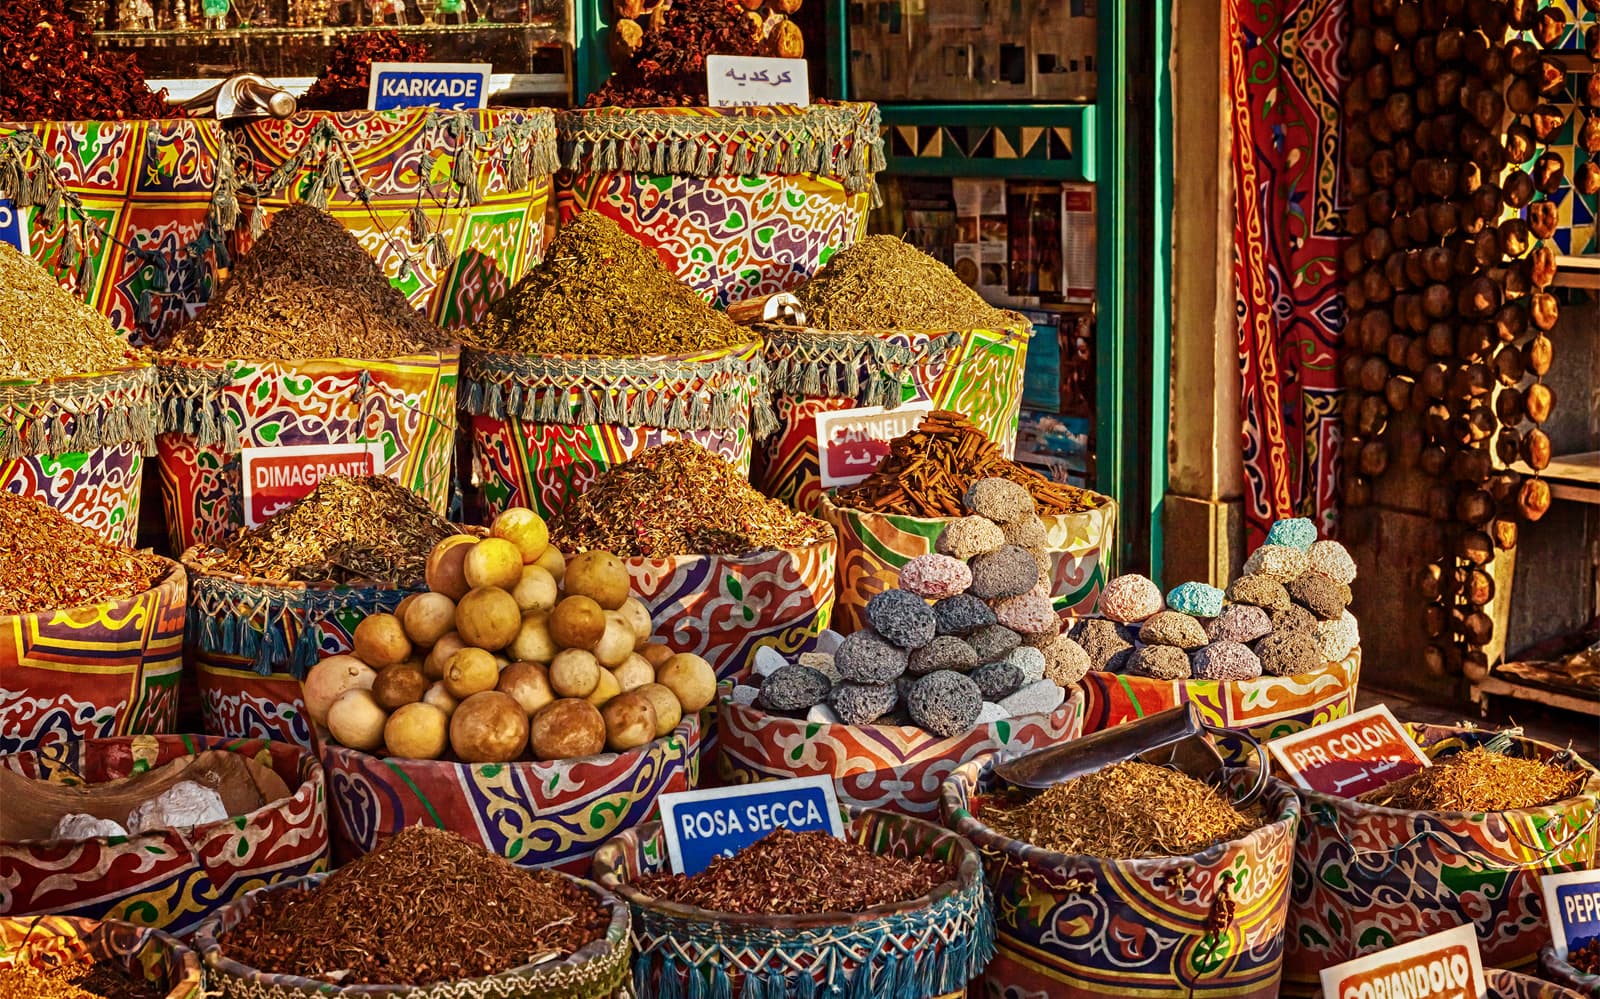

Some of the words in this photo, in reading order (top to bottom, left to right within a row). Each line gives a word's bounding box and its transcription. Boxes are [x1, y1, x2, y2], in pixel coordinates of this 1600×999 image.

[382, 79, 477, 97] KARKADE
[726, 68, 792, 86] كركديه
[1292, 745, 1332, 771] PER
[1327, 721, 1397, 759] COLON
[681, 808, 744, 840] ROSA
[746, 799, 823, 832] SECCA
